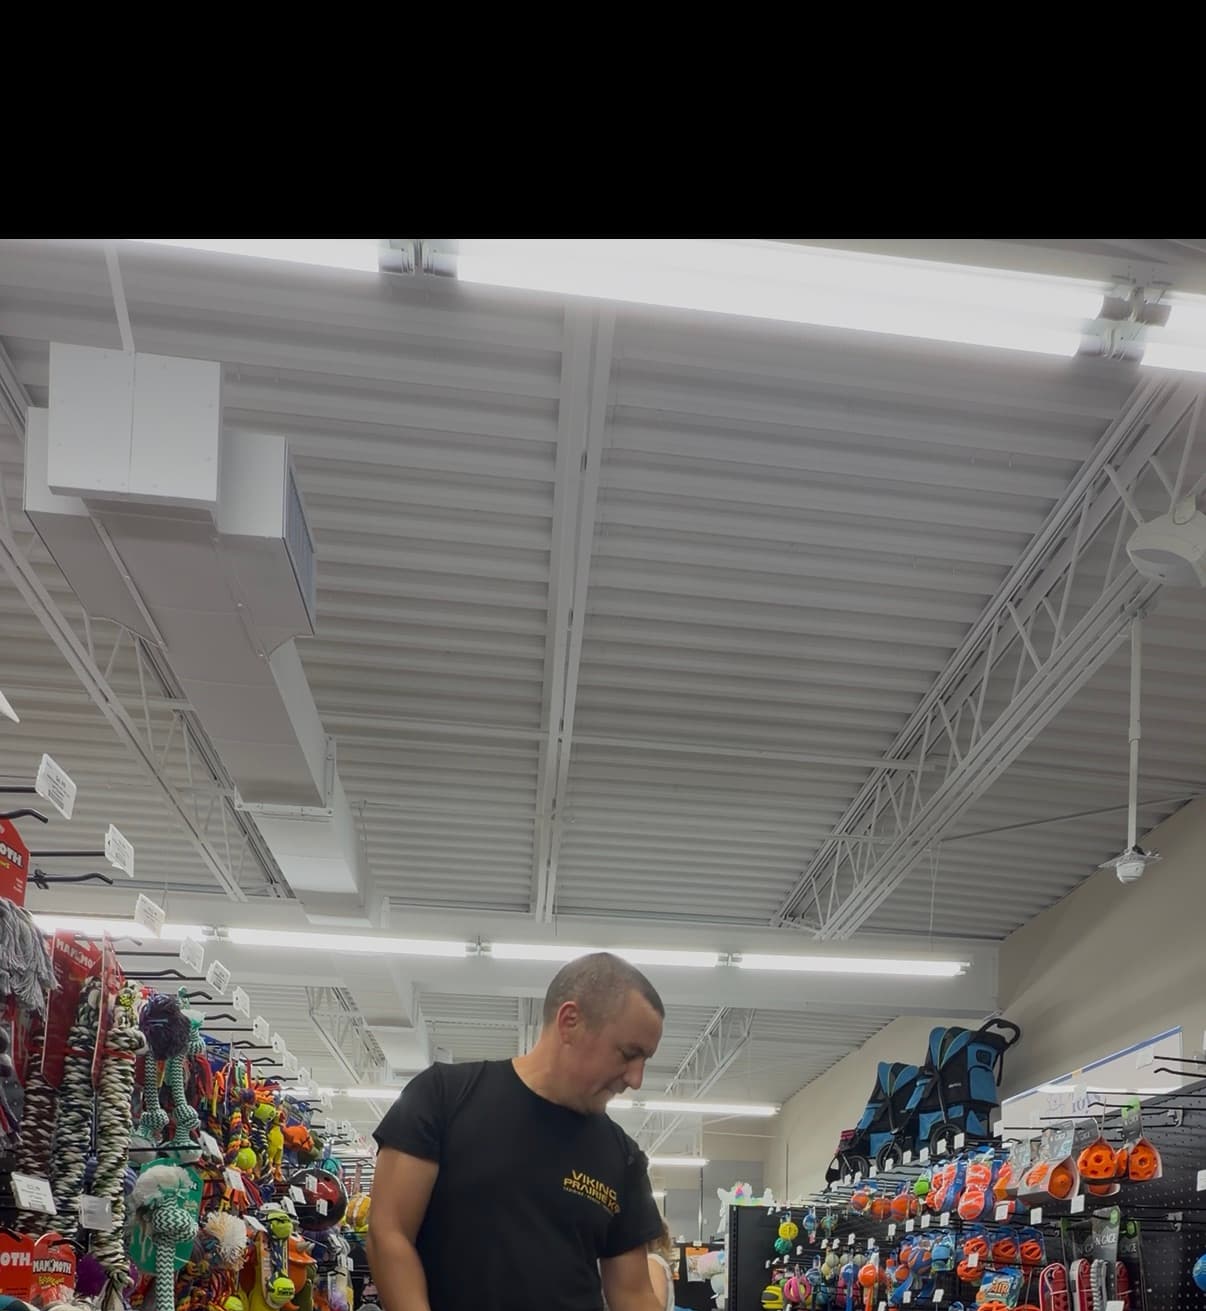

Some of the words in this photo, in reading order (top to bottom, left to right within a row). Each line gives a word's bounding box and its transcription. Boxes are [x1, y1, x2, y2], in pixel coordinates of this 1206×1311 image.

[564, 1178, 608, 1204] PRAIRIE
[572, 1169, 617, 1201] VIKING
[33, 1259, 72, 1274] MAMMOTH
